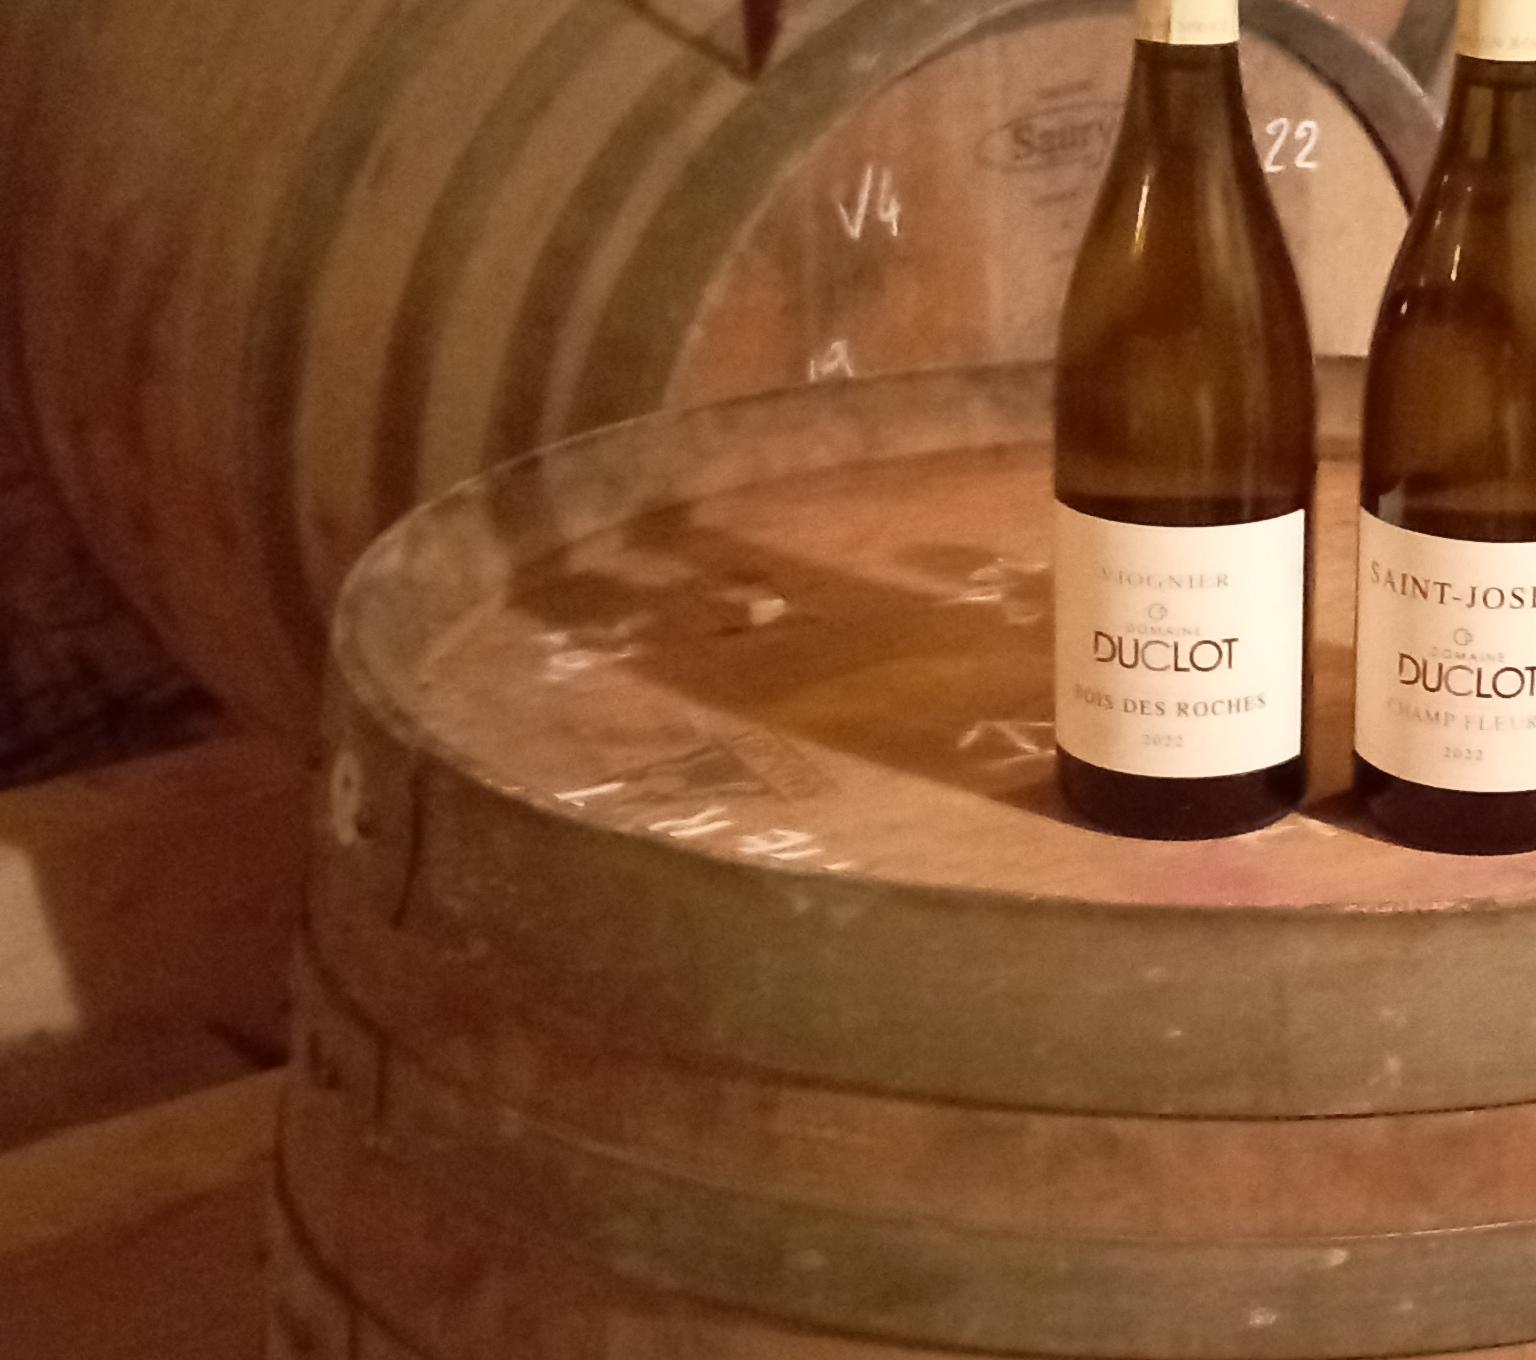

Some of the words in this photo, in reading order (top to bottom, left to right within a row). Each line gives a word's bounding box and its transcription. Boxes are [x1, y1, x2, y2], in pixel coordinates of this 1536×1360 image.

[1263, 117, 1319, 173] 22
[1093, 630, 1239, 672] DUCLOT
[1123, 698, 1166, 717] DES
[1176, 692, 1267, 718] ROCHES
